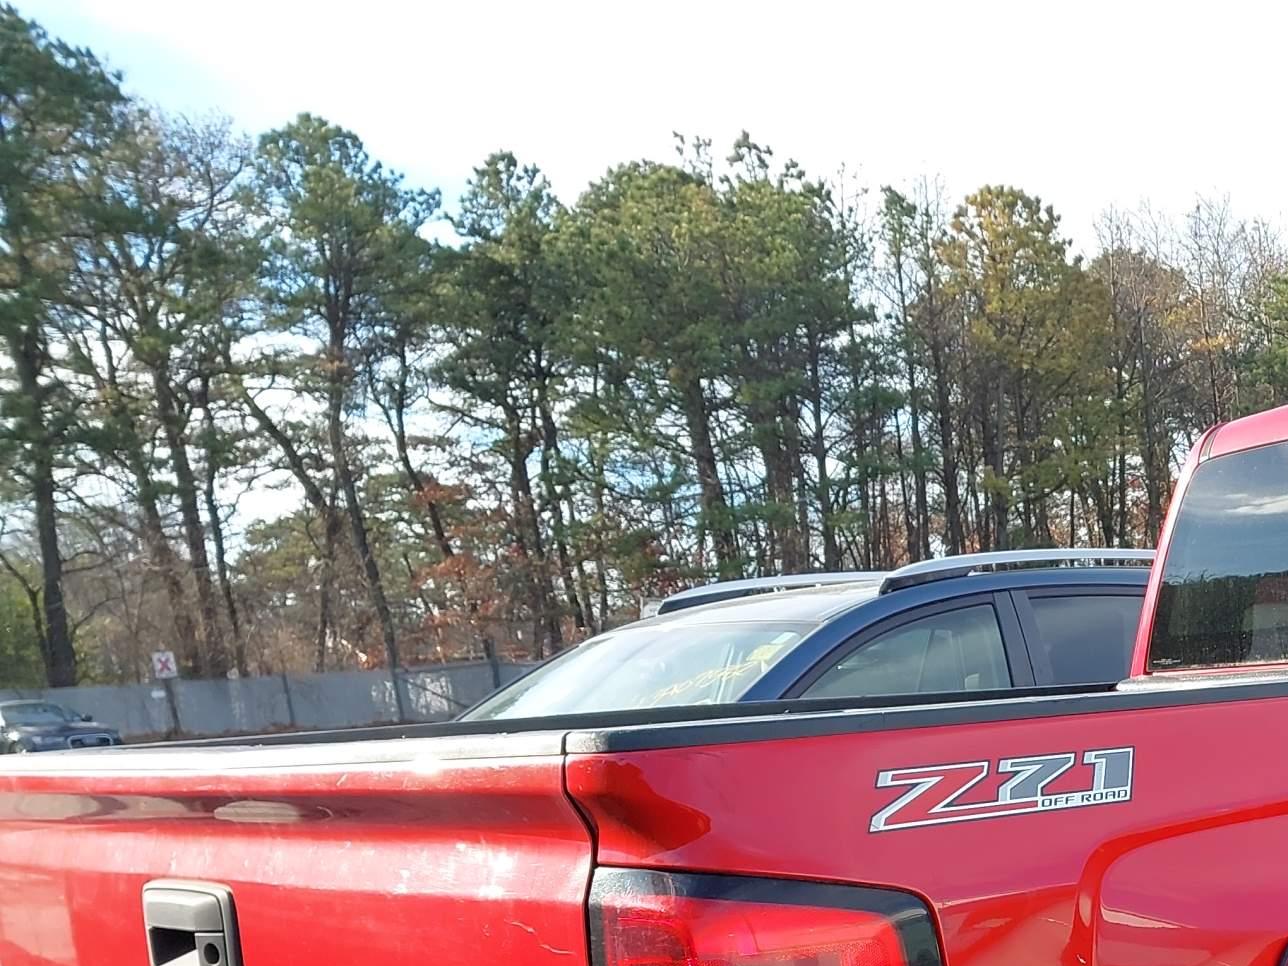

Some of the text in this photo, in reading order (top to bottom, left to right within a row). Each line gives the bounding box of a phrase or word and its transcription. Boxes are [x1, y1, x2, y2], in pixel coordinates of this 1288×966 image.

[868, 745, 1135, 833] Z71
[1041, 789, 1128, 808] OFF ROAD
